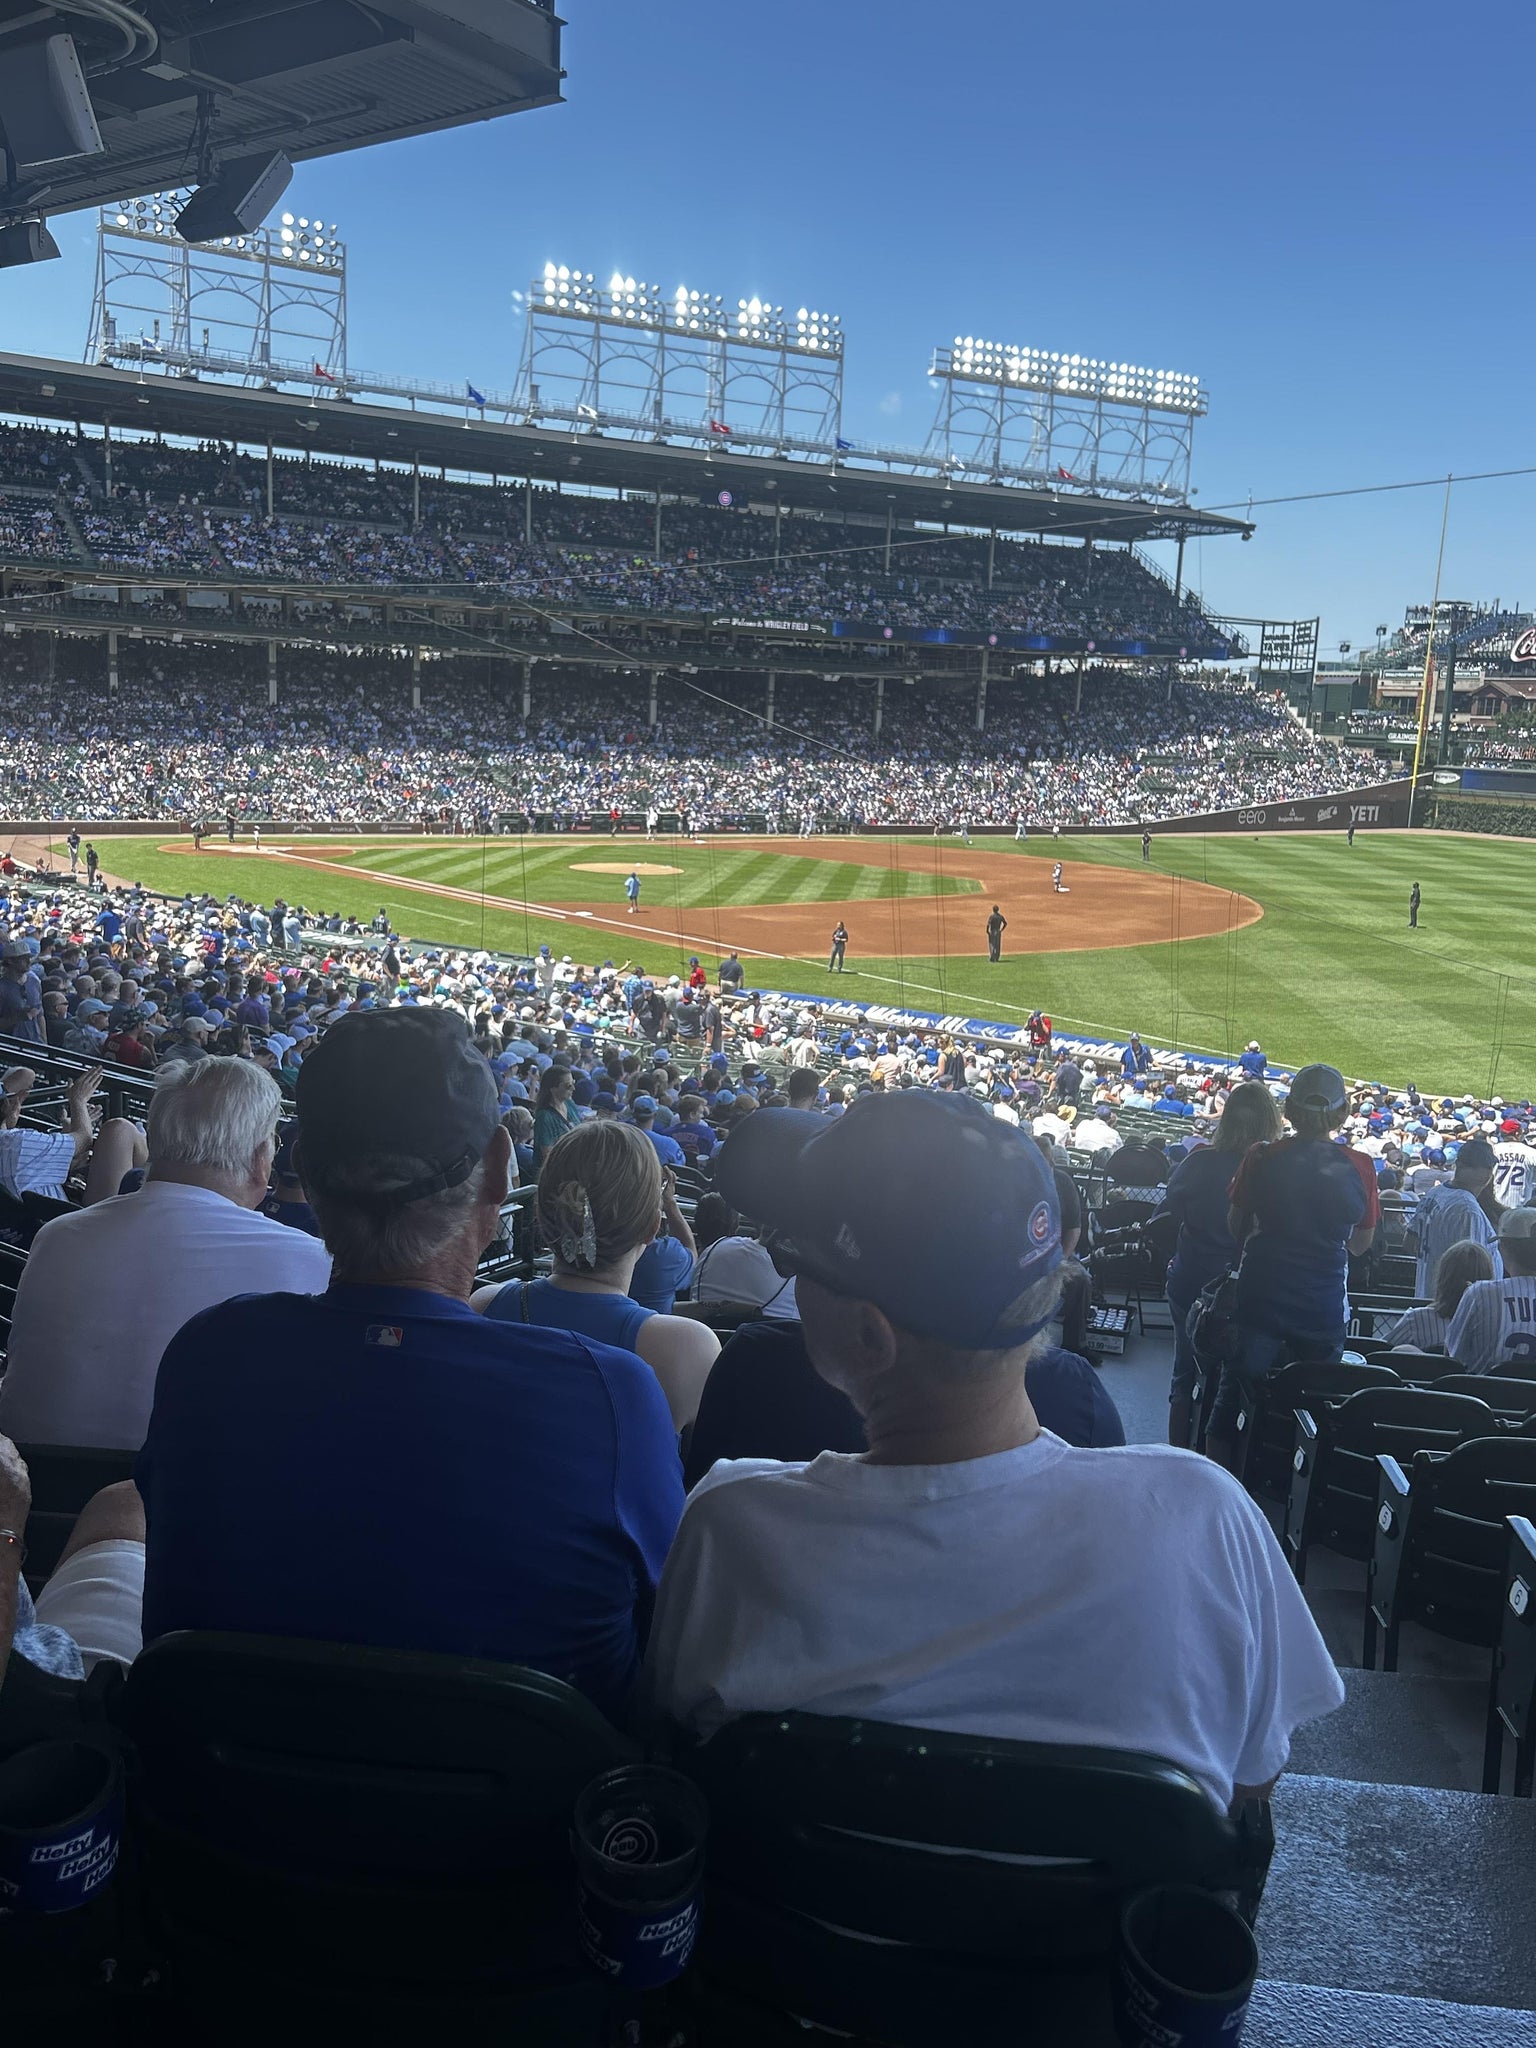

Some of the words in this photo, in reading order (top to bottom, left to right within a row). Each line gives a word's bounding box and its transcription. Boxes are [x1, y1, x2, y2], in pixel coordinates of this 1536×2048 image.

[731, 617, 757, 627] Welcome
[764, 620, 791, 630] WRIGLEY
[791, 621, 809, 631] FIELD
[1238, 810, 1266, 824] eero
[1350, 805, 1380, 822] YETI
[1499, 1152, 1526, 1163] ASSAD
[1496, 1165, 1526, 1186] 72
[1504, 1296, 1536, 1323] TU
[1515, 1589, 1523, 1606] 6
[34, 1836, 91, 1861] Hefty
